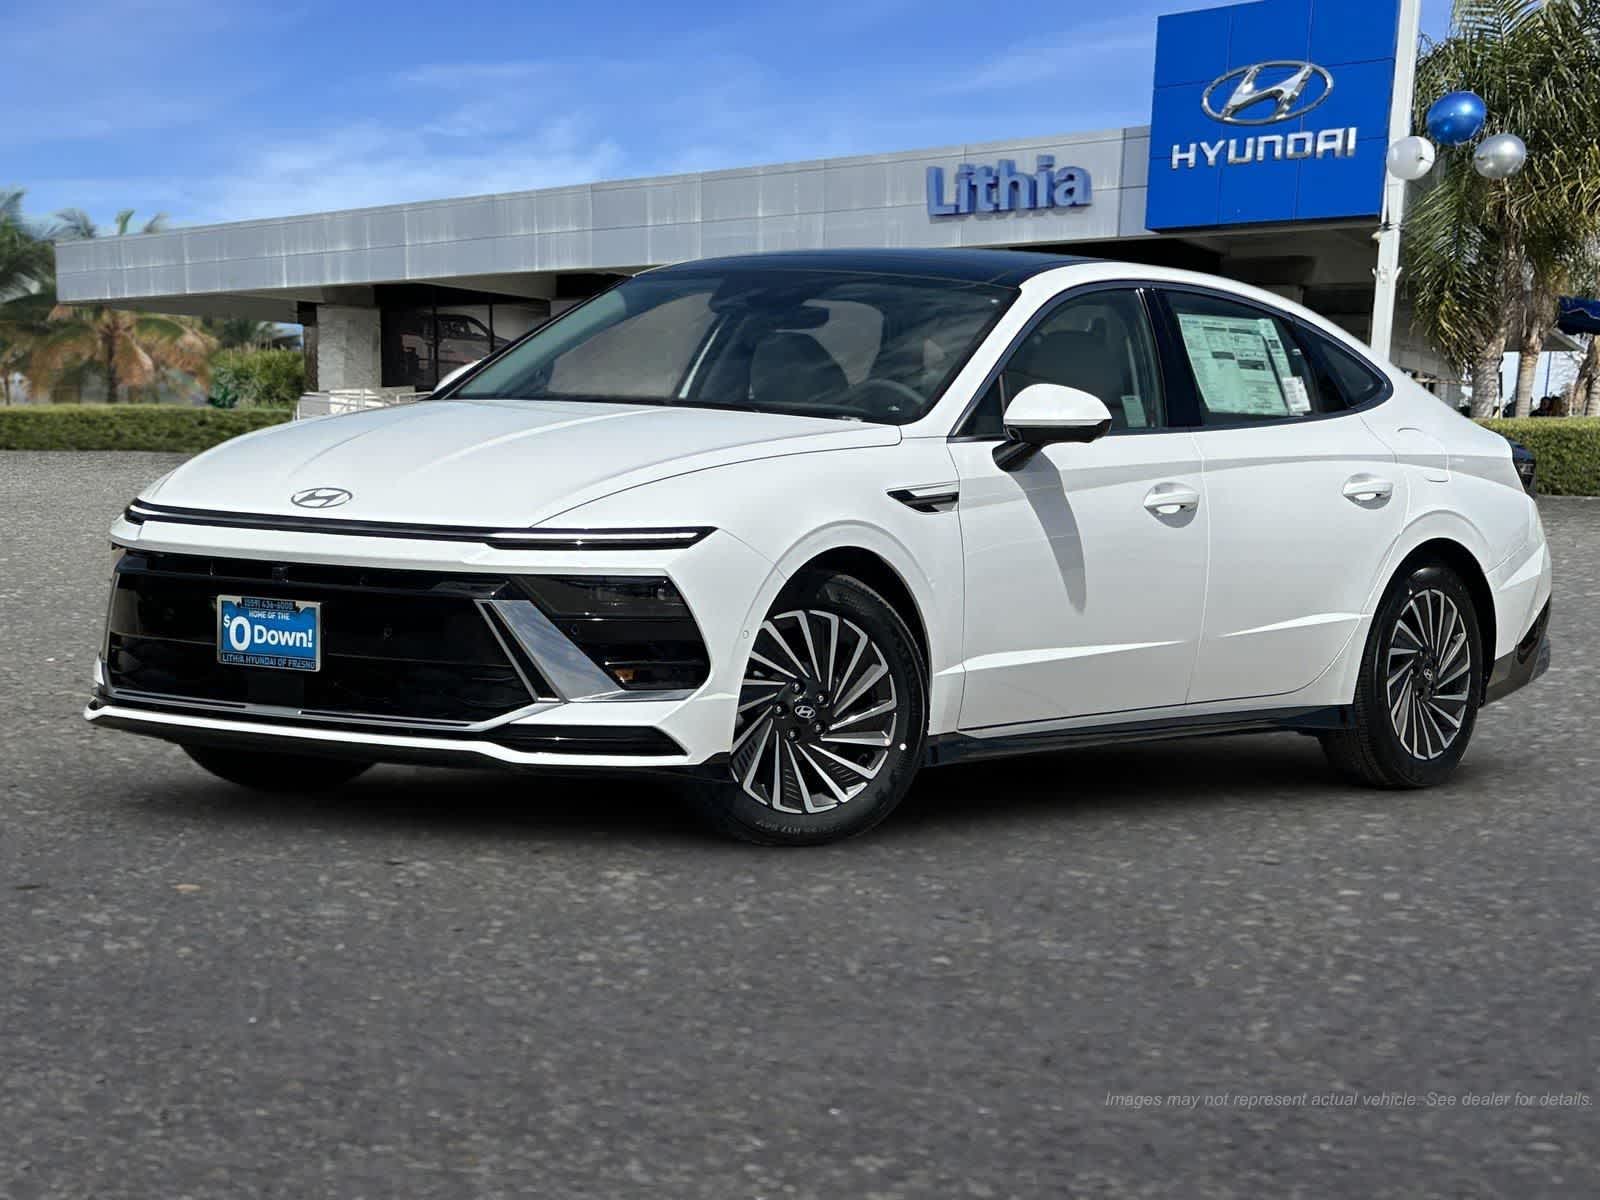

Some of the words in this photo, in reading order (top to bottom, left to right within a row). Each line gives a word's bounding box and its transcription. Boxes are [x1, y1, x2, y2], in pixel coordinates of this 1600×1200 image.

[1171, 127, 1357, 170] HYUNDAI
[926, 154, 1092, 217] Lithia
[249, 610, 267, 618] HOME
[267, 611, 276, 619] OF
[277, 611, 290, 620] THE
[254, 625, 313, 648] Down!
[223, 654, 244, 664] LITHIA
[246, 655, 276, 666] HYUNDAI
[277, 658, 287, 668] OF
